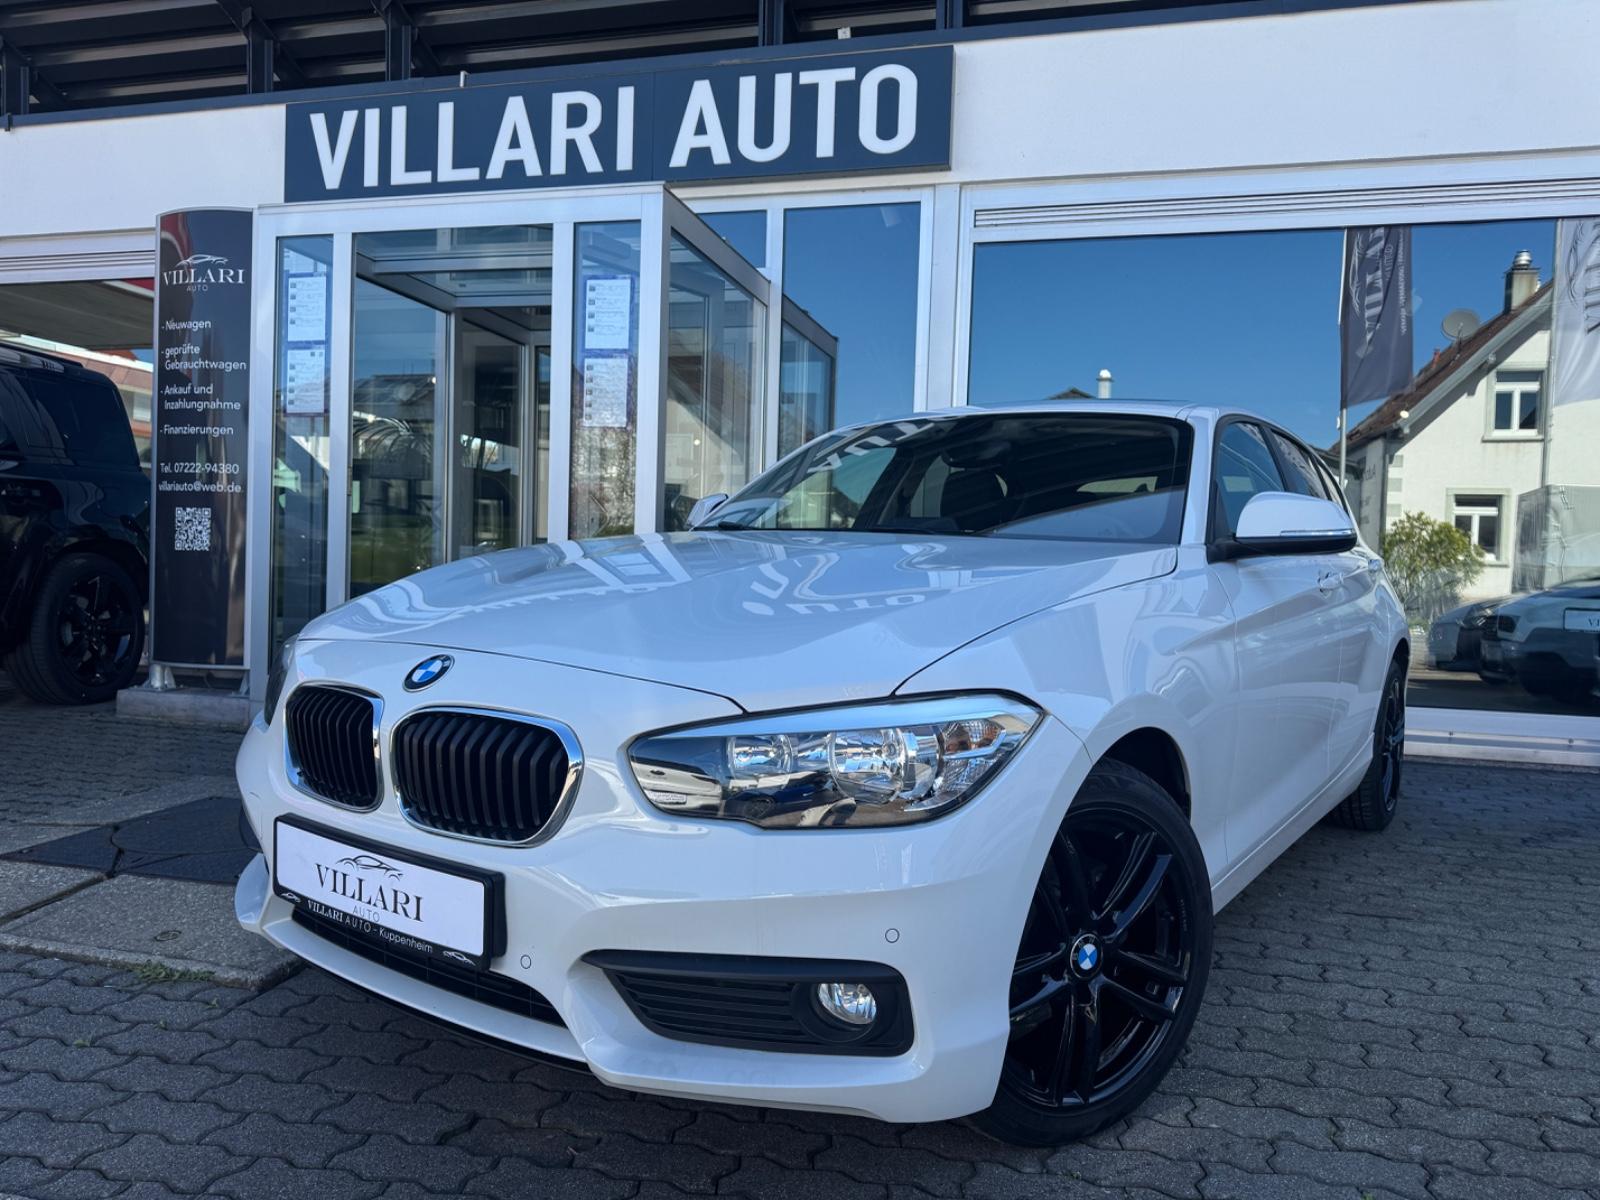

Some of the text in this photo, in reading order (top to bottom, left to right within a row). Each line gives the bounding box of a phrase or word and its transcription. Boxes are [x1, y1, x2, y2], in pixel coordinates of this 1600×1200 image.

[310, 63, 918, 191] VILLARI AUTO
[163, 268, 245, 285] VILLARI
[165, 319, 211, 331] Neuwagen
[165, 344, 200, 358] geprüfte
[165, 358, 247, 372] Gebrauchtwagen
[165, 383, 192, 395] Ankauf
[193, 384, 214, 394] und
[164, 398, 241, 412] Inzahlungnahme
[163, 424, 234, 437] Finanzierungen
[160, 463, 240, 474] Tel. 07222-94380
[158, 481, 242, 493] villariauto@web.de
[315, 863, 424, 922] VILLARI
[353, 905, 381, 923] AUTO
[307, 900, 344, 923] VILLARI
[345, 917, 371, 934] AUTO
[379, 927, 434, 954] Kuppenheim
